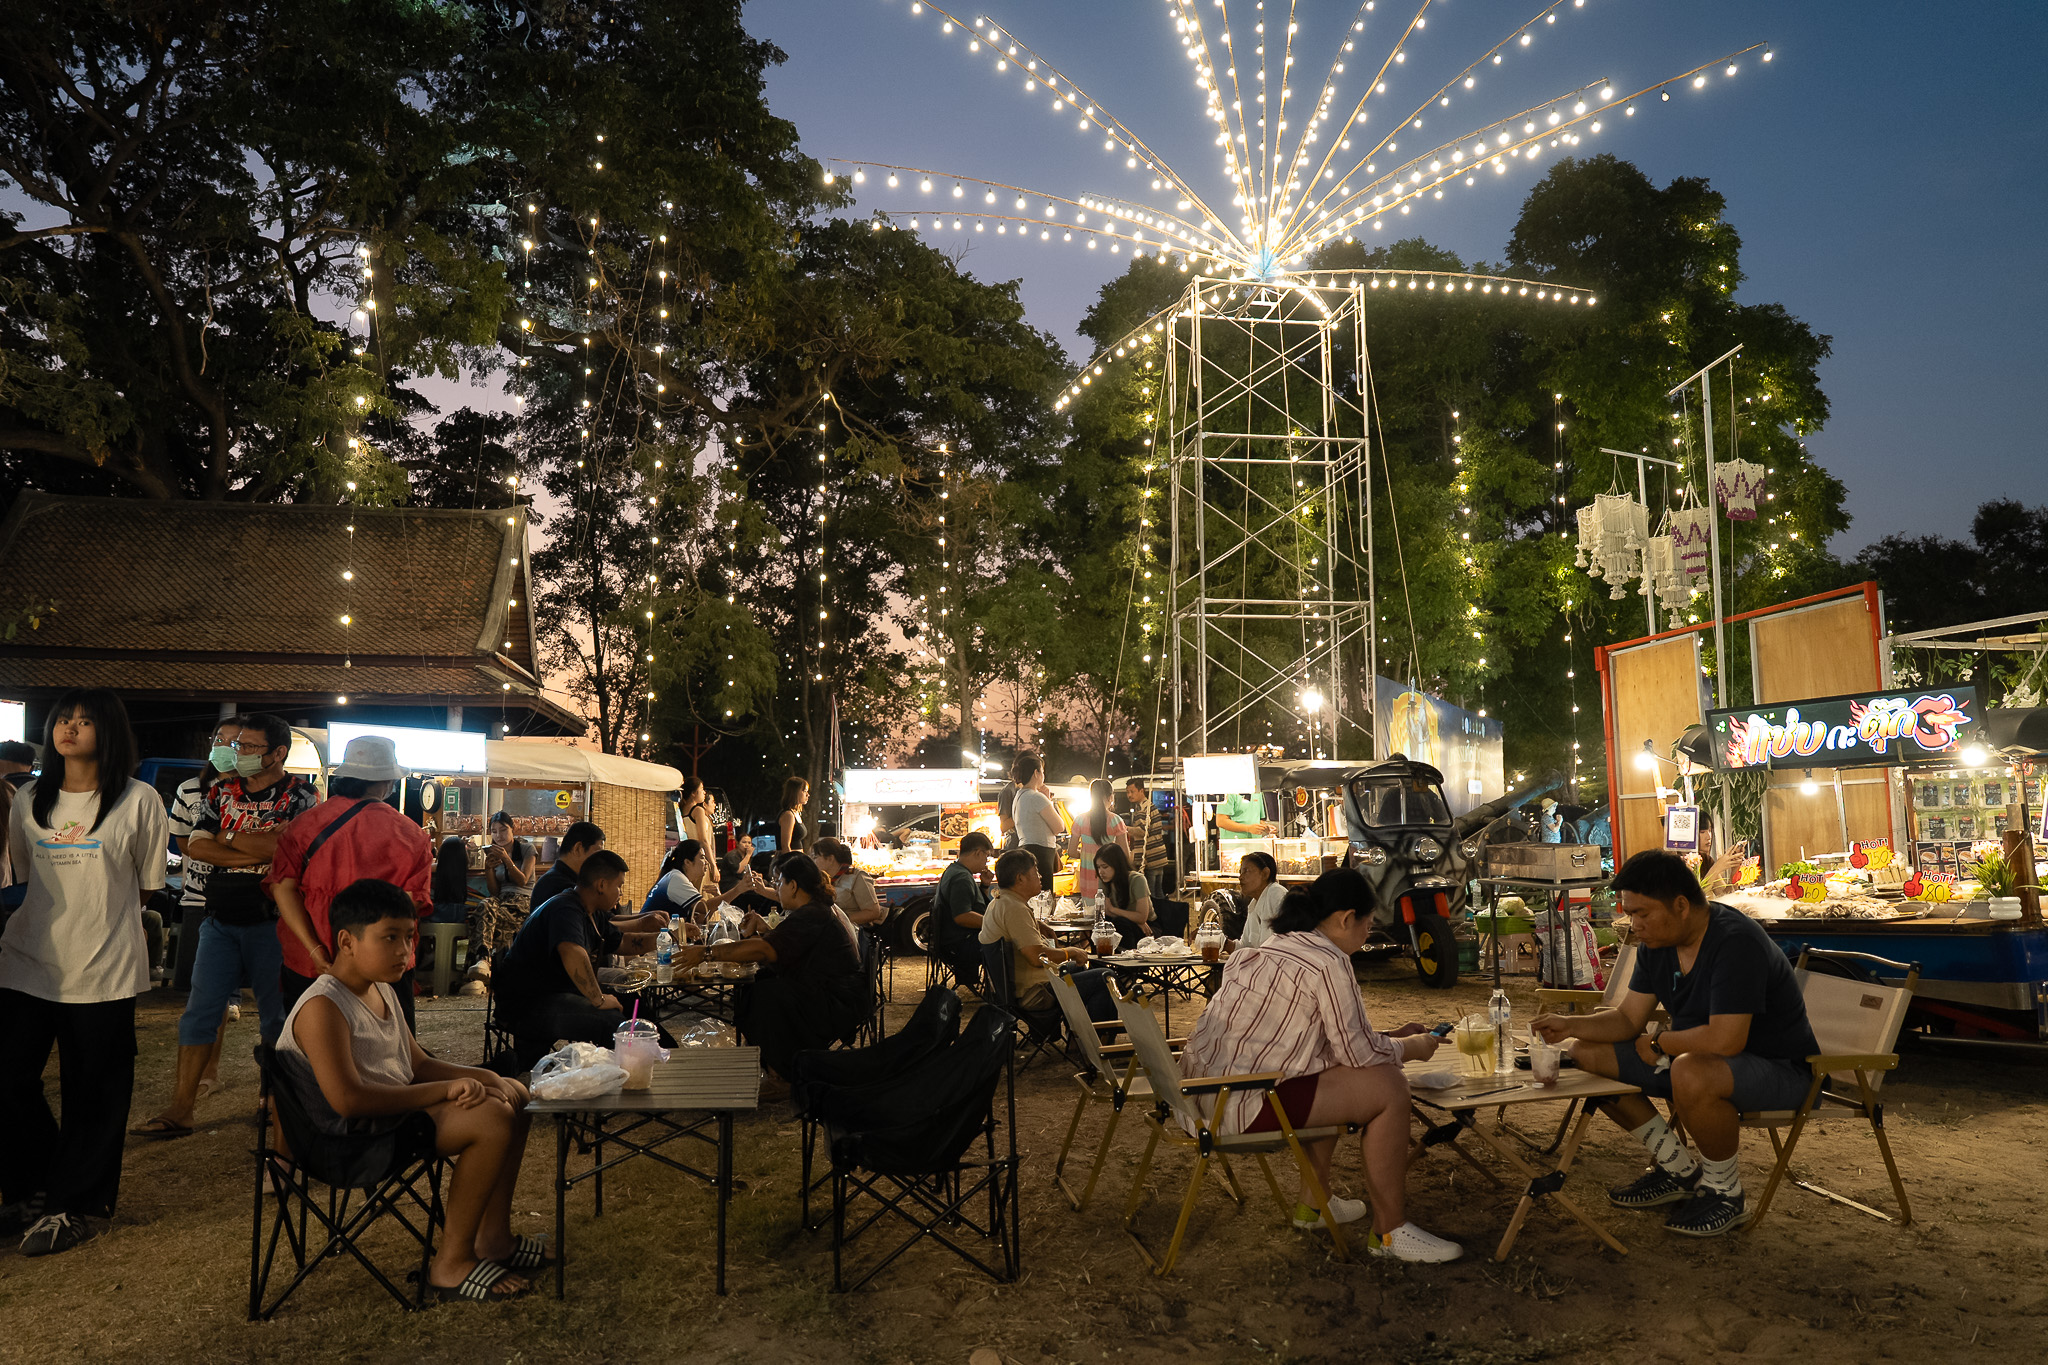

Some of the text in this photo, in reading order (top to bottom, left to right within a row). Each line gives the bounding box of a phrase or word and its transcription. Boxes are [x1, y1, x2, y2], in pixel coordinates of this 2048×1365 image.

[232, 801, 274, 810] BREAK THE
[1861, 838, 1888, 849] HOT!
[1868, 850, 1888, 866] 150
[1743, 867, 1755, 882] 80
[1923, 871, 1952, 883] HOT!
[1805, 886, 1819, 899] 60
[1925, 884, 1944, 901] 80
